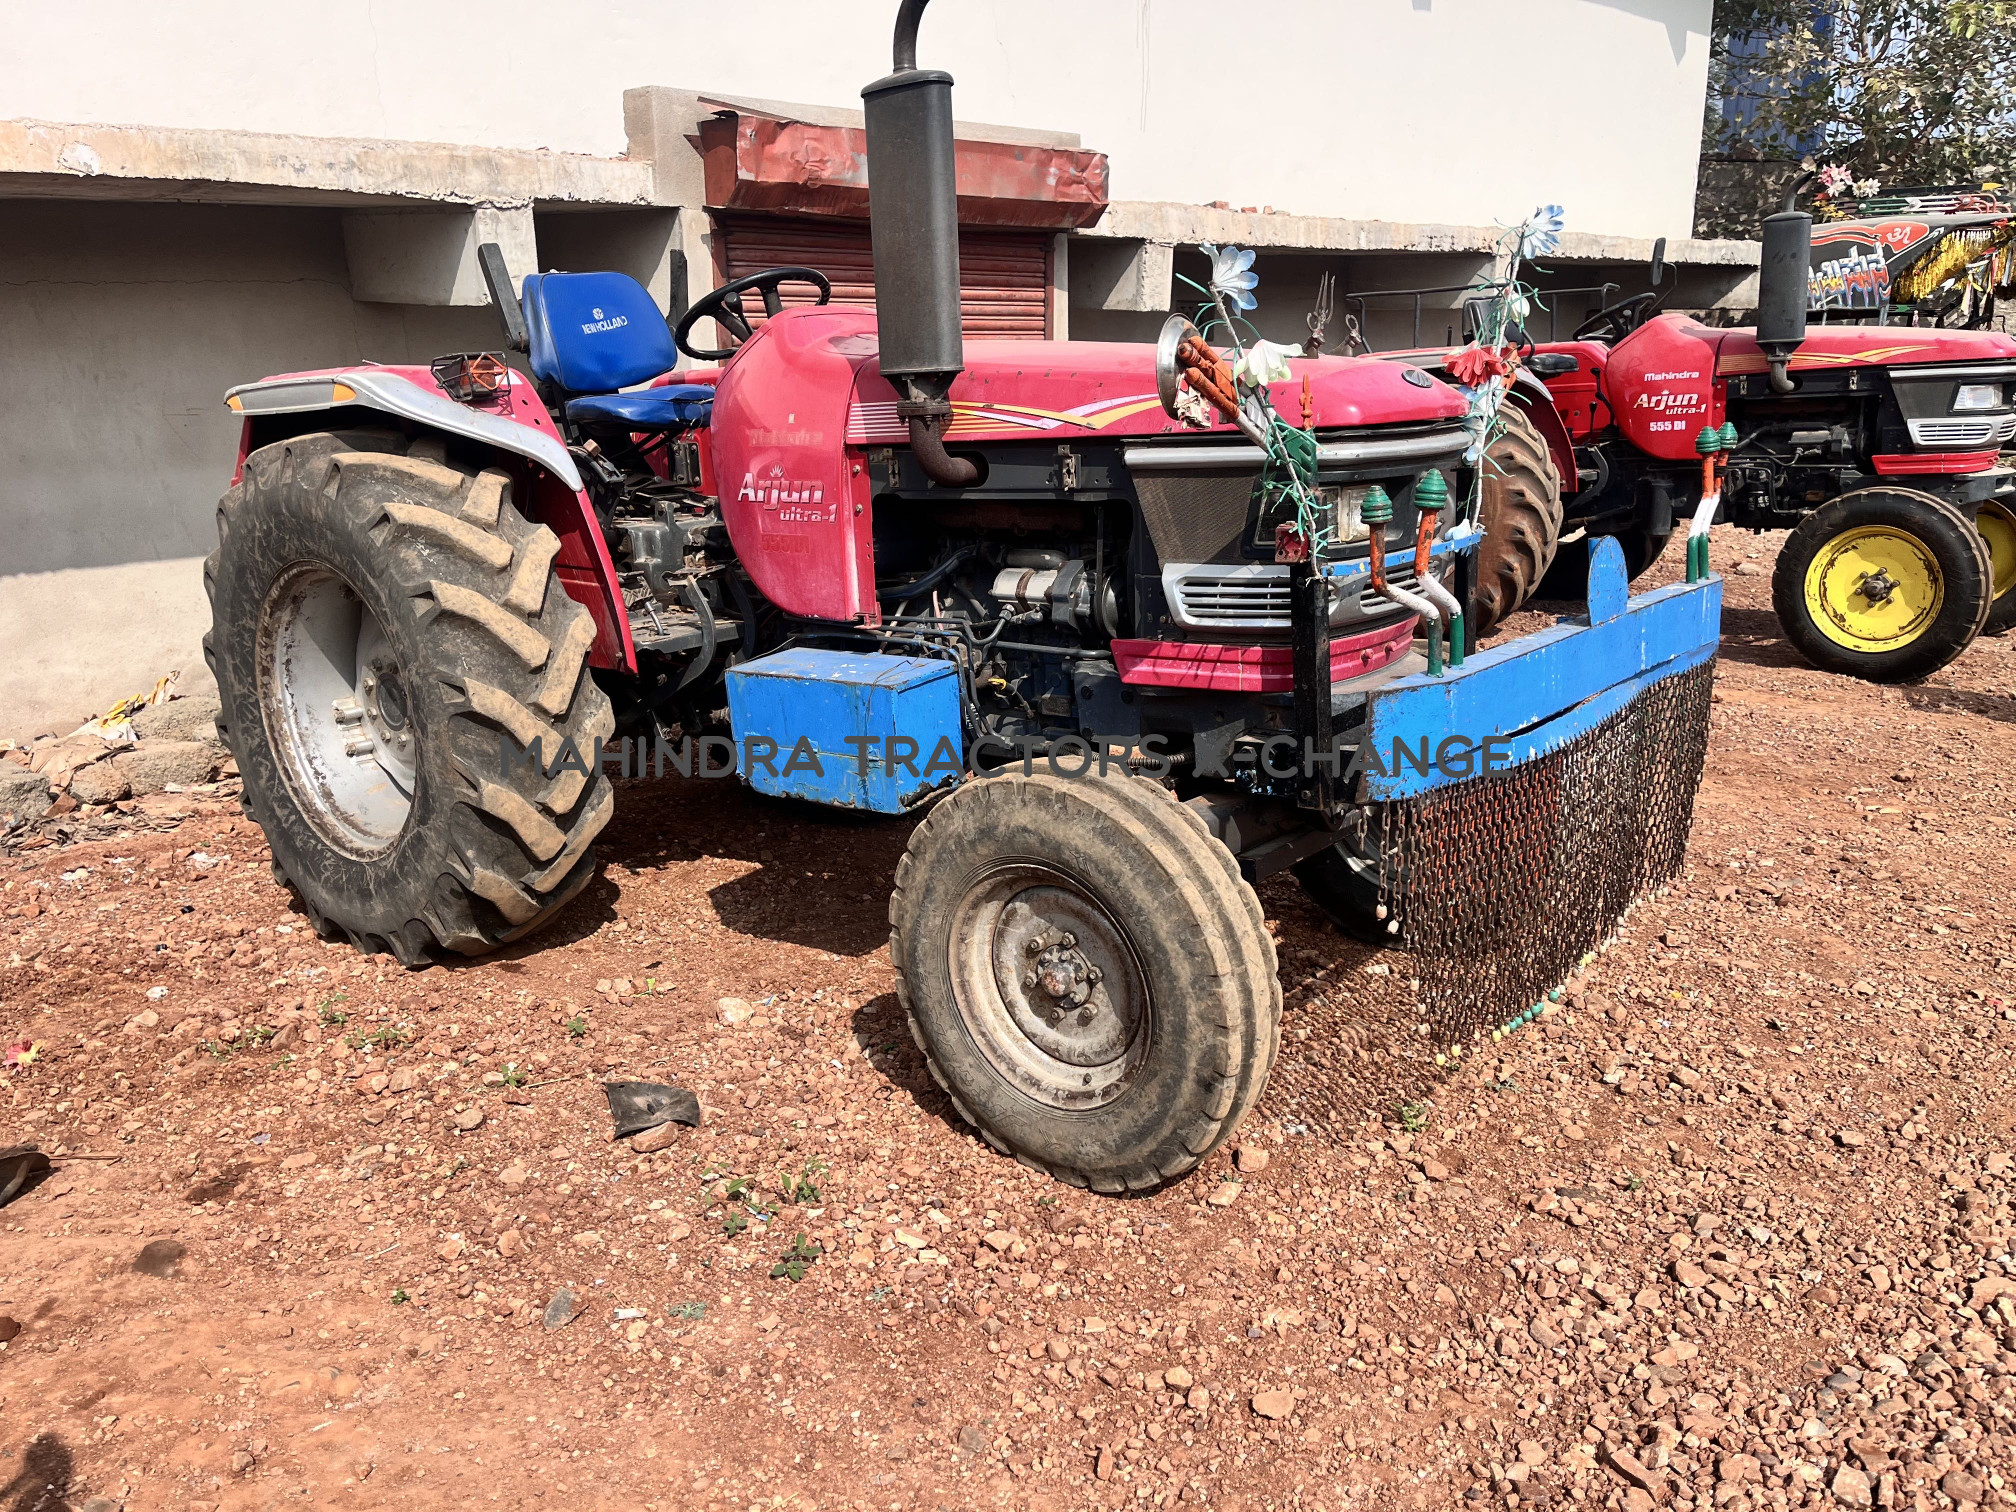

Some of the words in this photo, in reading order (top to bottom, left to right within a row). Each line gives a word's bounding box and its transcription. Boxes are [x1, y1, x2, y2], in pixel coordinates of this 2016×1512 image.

[1644, 371, 1700, 382] Mahindra
[1633, 389, 1699, 411] Arjun
[1665, 403, 1707, 415] ultra-1
[1649, 421, 1672, 432] 555
[1673, 420, 1686, 431] DI
[737, 464, 825, 511] Arjun
[780, 503, 838, 523] ultra-1
